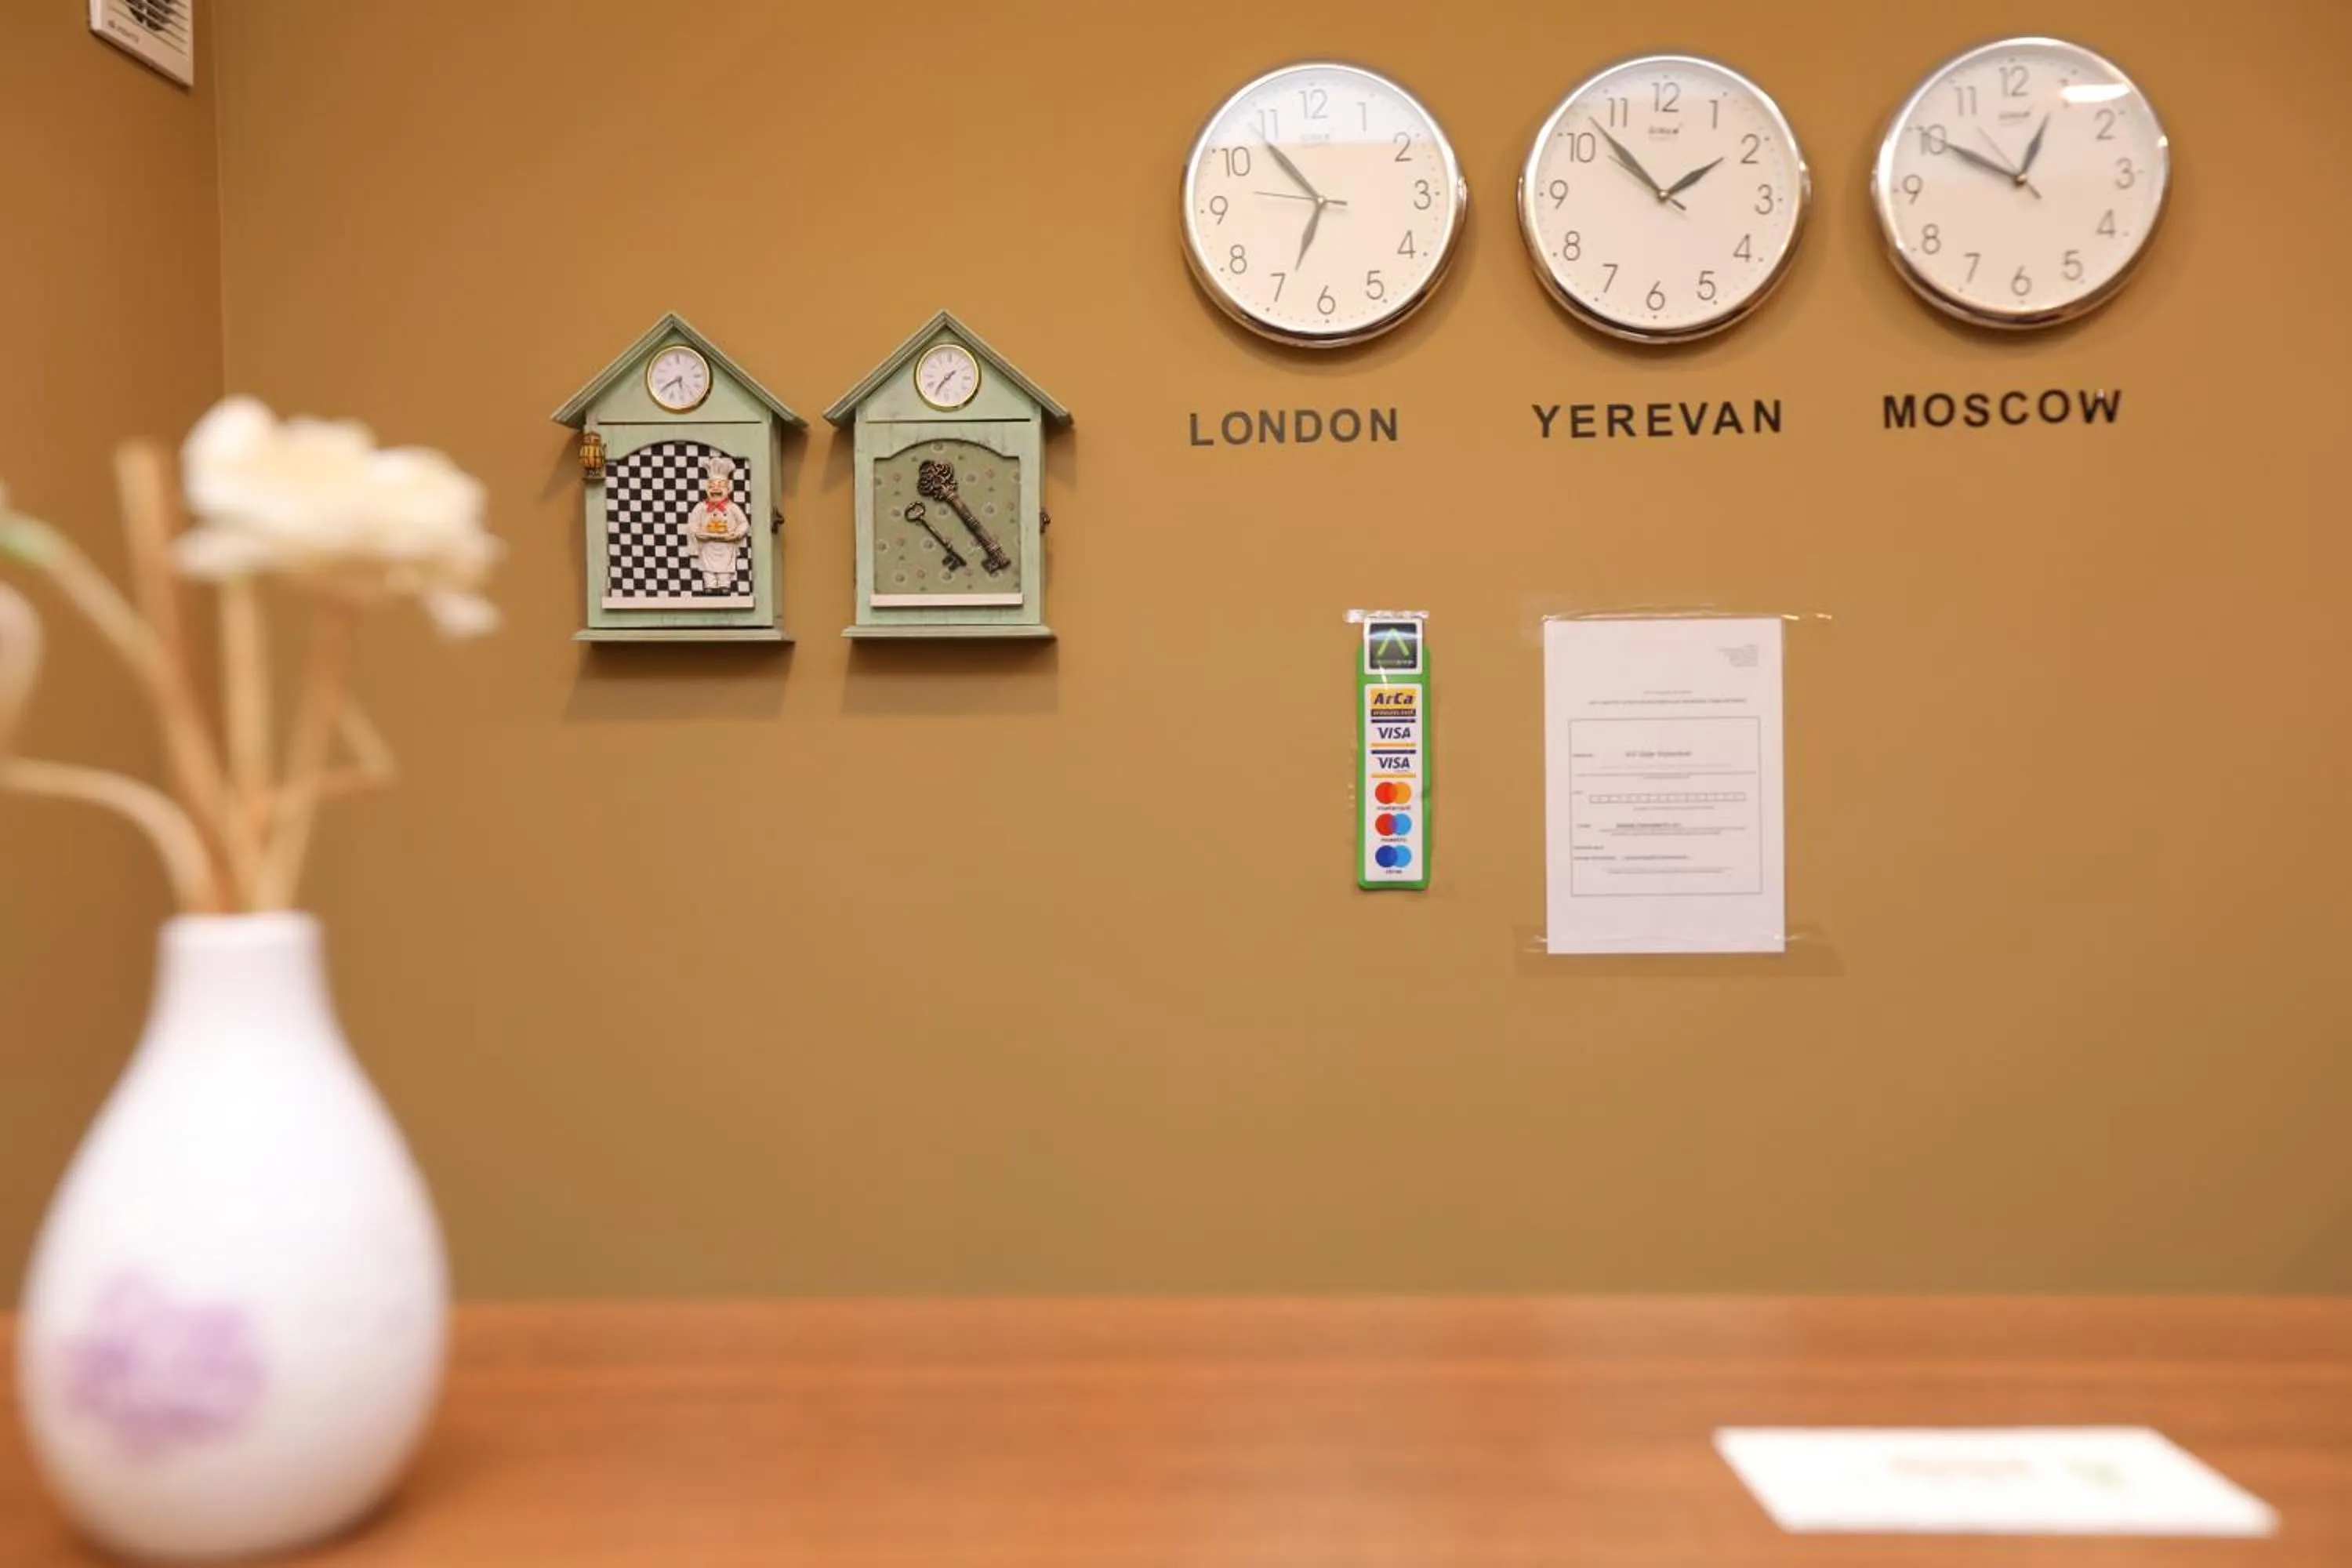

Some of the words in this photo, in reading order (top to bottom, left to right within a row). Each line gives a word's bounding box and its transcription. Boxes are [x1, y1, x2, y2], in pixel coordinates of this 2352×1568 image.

[1999, 66, 2029, 97] 12
[1298, 89, 1328, 119] 12
[1651, 82, 1681, 112] 12
[1955, 85, 1977, 117] 11
[1258, 109, 1279, 139] 11
[1357, 102, 1367, 131] 1
[1607, 98, 1628, 128] 11
[1709, 100, 1719, 129] 1
[2094, 108, 2114, 141] 2
[1393, 132, 1412, 162] 2
[1567, 132, 1595, 162] 10
[1740, 134, 1760, 164] 2
[1918, 125, 1947, 156] 10
[1222, 146, 1250, 176] 10
[2116, 158, 2135, 189] 3
[1414, 180, 1431, 210] 3
[1549, 180, 1567, 209] 9
[1755, 183, 1773, 215] 3
[1902, 174, 1923, 205] 9
[1210, 195, 1229, 224] 9
[2096, 209, 2115, 238] 4
[1397, 230, 1415, 259] 4
[1563, 230, 1581, 261] 8
[1733, 234, 1751, 261] 4
[1922, 223, 1941, 255] 8
[1230, 245, 1247, 274] 8
[1964, 252, 1980, 282] 7
[2060, 250, 2083, 281] 5
[1270, 273, 1286, 302] 7
[1366, 270, 1384, 299] 5
[1602, 263, 1618, 292] 7
[1697, 270, 1716, 300] 5
[2011, 265, 2032, 296] 6
[1317, 285, 1335, 315] 6
[1646, 281, 1665, 310] 6
[1531, 399, 1781, 438] YEREVAN
[1883, 389, 2122, 429] MOSCOW
[1189, 408, 1398, 446] LONDON
[1374, 692, 1414, 705] ArCa
[1377, 727, 1410, 739] VISA
[1378, 757, 1410, 769] VISA
